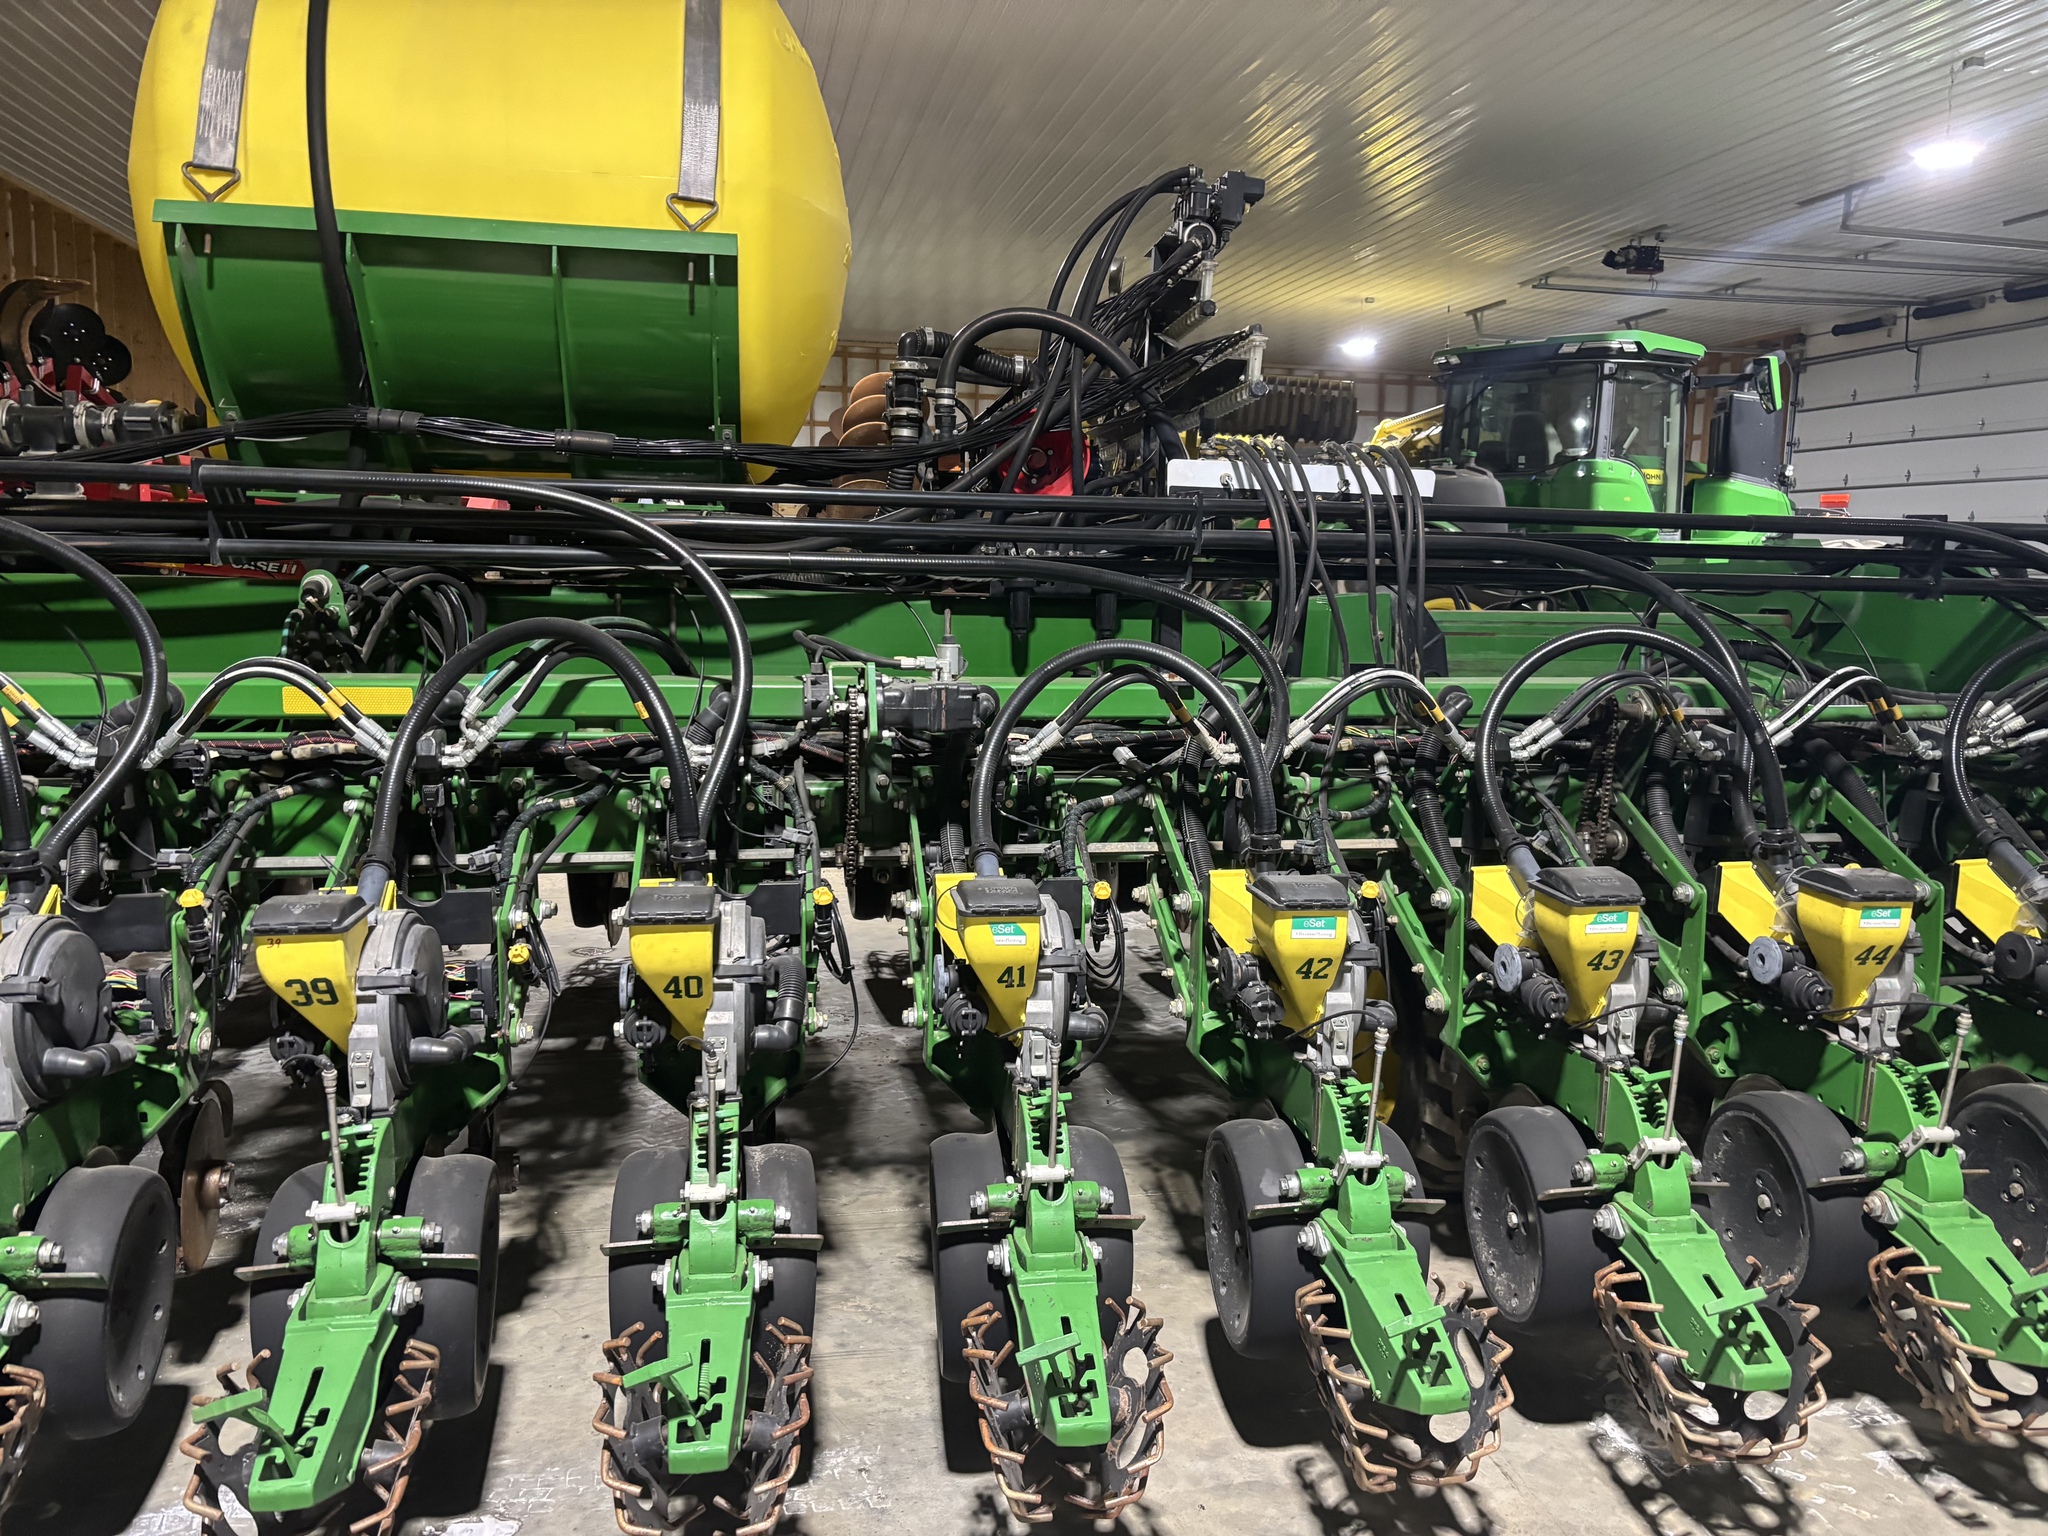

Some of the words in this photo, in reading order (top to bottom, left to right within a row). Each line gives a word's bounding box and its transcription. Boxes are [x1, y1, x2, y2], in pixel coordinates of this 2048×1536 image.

[1303, 918, 1326, 928] eSet
[1597, 913, 1618, 923] eSet
[1871, 908, 1891, 918] eSet
[992, 924, 1015, 934] eSet
[267, 938, 281, 948] 39
[1587, 949, 1624, 971] 43
[1854, 944, 1894, 966] 44
[997, 965, 1026, 989] 41
[1295, 957, 1334, 980] 42
[284, 977, 339, 1007] 39
[663, 975, 703, 999] 40
